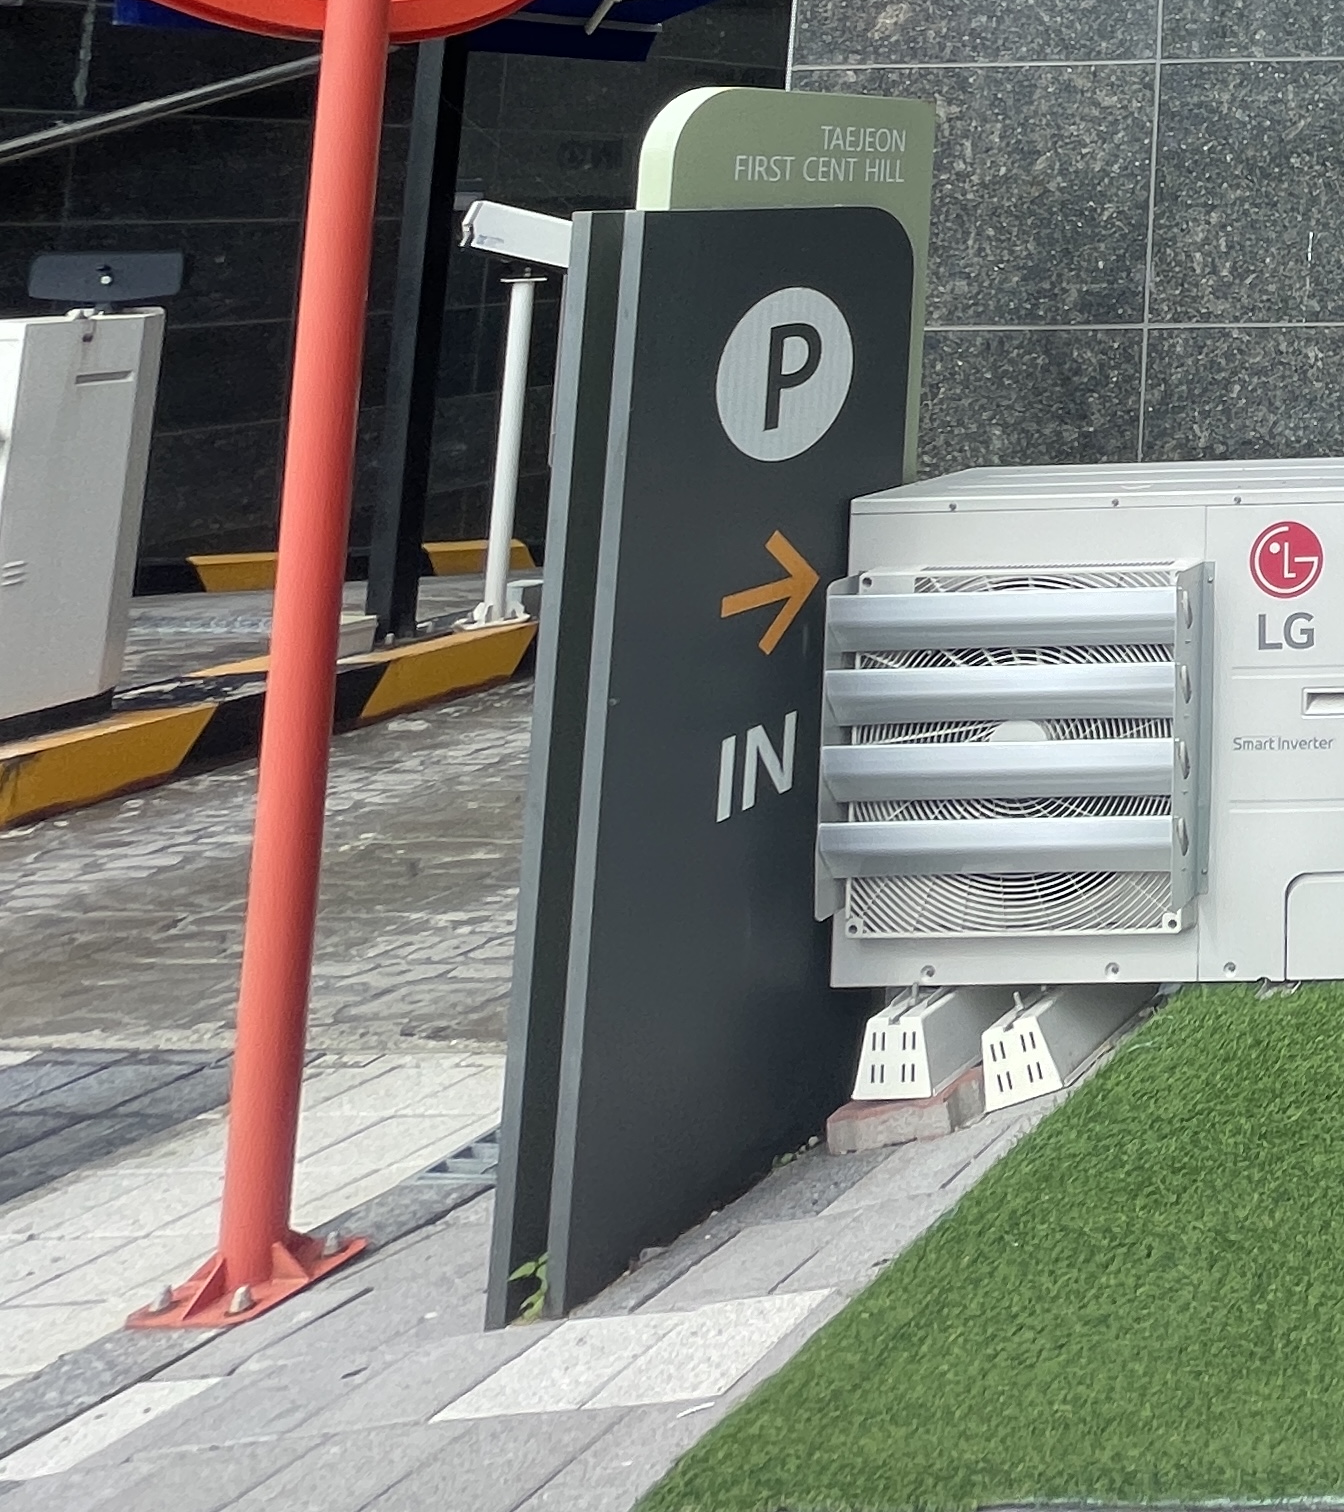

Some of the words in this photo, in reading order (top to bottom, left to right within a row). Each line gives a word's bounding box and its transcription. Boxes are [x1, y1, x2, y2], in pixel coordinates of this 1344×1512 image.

[820, 124, 907, 153] TAEJEON
[733, 154, 796, 182] FIRST
[801, 155, 859, 183] CENT
[863, 157, 906, 183] HILL
[763, 321, 822, 431] P
[1257, 611, 1316, 651] LG
[1232, 736, 1275, 751] Smart
[1276, 736, 1333, 751] Inverter
[715, 710, 799, 823] IN
